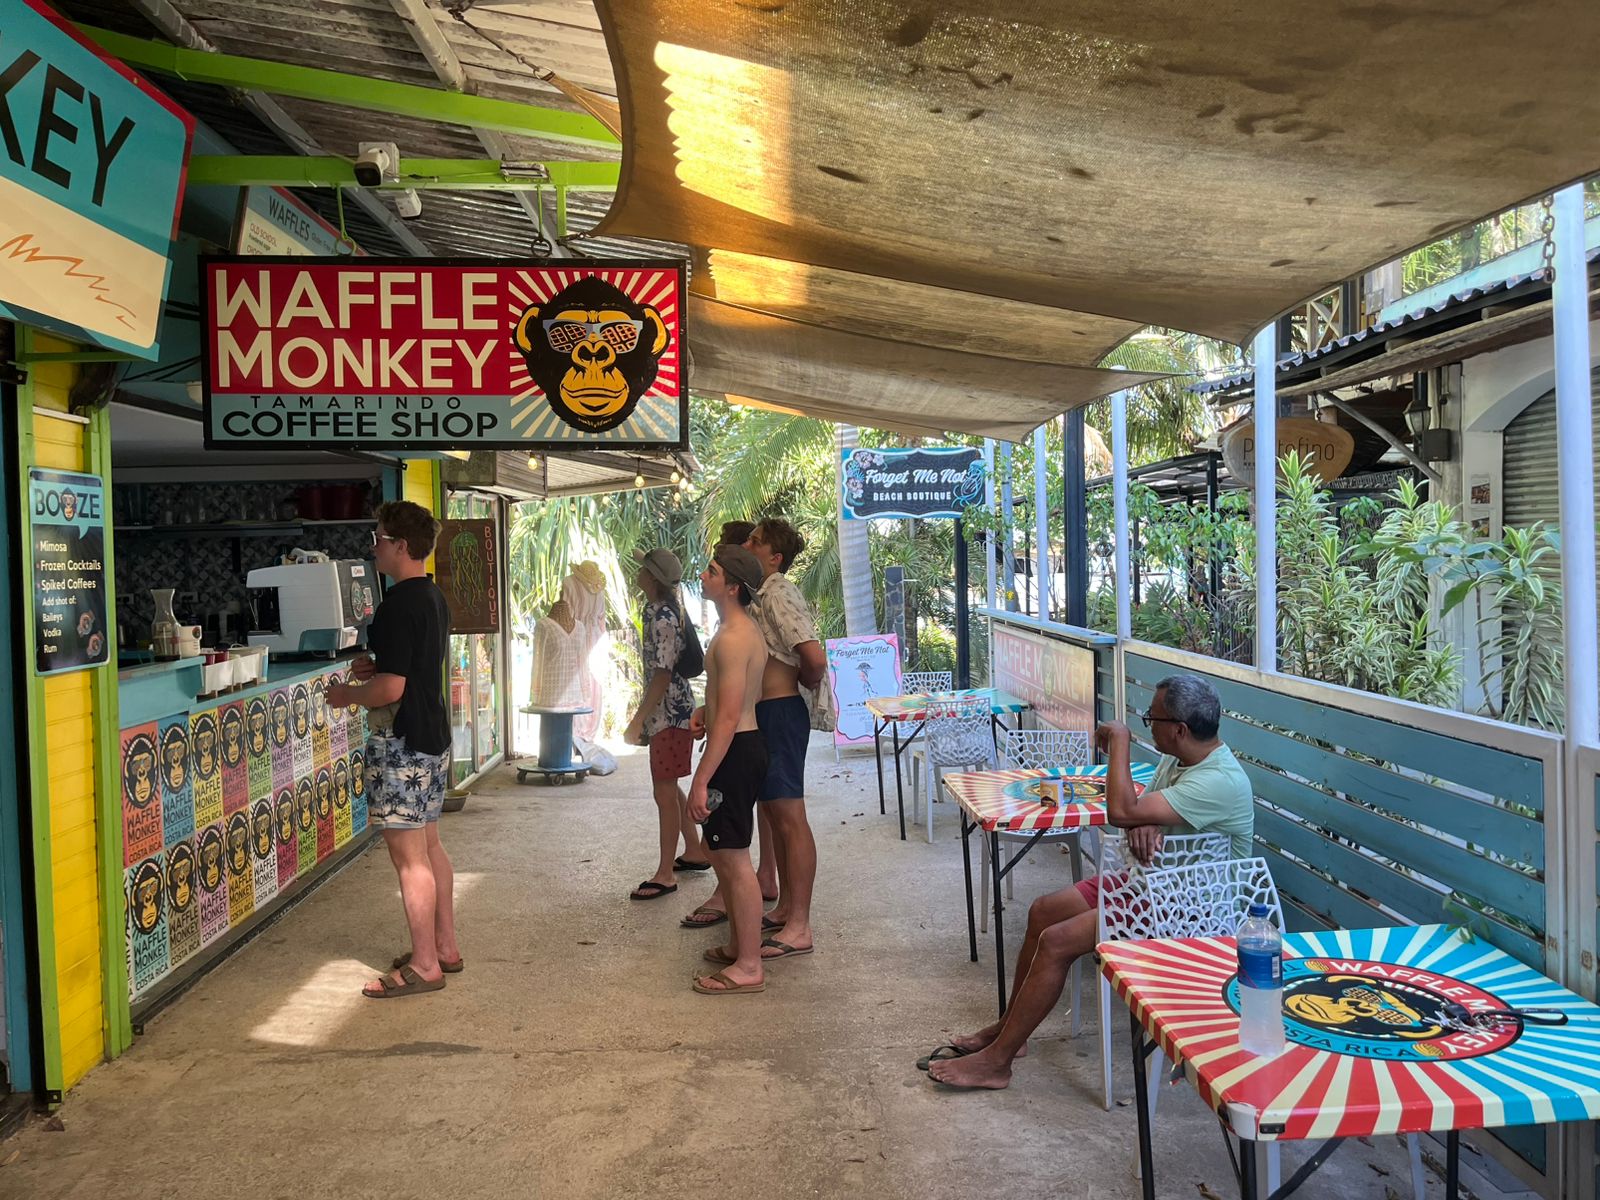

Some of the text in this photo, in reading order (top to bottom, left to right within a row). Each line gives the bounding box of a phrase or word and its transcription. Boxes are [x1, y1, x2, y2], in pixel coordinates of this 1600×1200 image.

[269, 195, 311, 241] WAFFLES
[215, 269, 498, 330] WAFFLE
[218, 330, 499, 388] MONKEY
[250, 395, 462, 409] TAMARINDO
[222, 411, 499, 438] COFFEE SHOP
[1243, 436, 1335, 461] Ptofino
[865, 468, 968, 488] Forget Me Not
[873, 491, 951, 501] BEACH BOUTIQUE
[40, 541, 67, 552] Mimosa
[40, 560, 101, 571] Frozen Cocktails
[484, 526, 497, 624] BOUTIQUE
[41, 578, 97, 592] Spiked Coffees
[42, 597, 54, 606] Add
[55, 597, 68, 606] shot
[42, 612, 63, 623] Baileys
[43, 629, 62, 638] Vodka
[44, 645, 58, 654] Rum
[836, 648, 861, 659] Forget
[861, 647, 874, 655] Me
[875, 646, 890, 654] Not
[994, 633, 1031, 678] WAFFLE
[273, 746, 293, 763] WAFFLE
[294, 737, 311, 754] WAFFLE
[249, 755, 271, 773] WAFFLE
[195, 777, 221, 796] WAFFLE
[249, 767, 271, 785] MONKEY
[163, 789, 193, 812] WAFFLE
[195, 791, 221, 809] MONKEY
[128, 804, 161, 831] WAFFLE
[164, 804, 193, 827] MONKEY
[196, 816, 211, 829] COSTA
[212, 810, 223, 820] RICA
[128, 820, 161, 844] MONKEY
[129, 848, 148, 863] COSTA
[149, 841, 162, 853] RICA
[255, 854, 276, 877] WAFFLE
[229, 870, 253, 896] WAFFLE
[255, 867, 276, 889] MONKEY
[201, 886, 227, 914] WAFFLE
[230, 884, 253, 907] MONKEY
[169, 906, 198, 935] WAFFLE
[201, 901, 227, 926] MONKEY
[231, 909, 244, 922] COSTA
[134, 927, 167, 957] WAFFLE
[170, 921, 198, 947] MONKEY
[202, 928, 218, 943] COSTA
[218, 919, 229, 931] RICA
[135, 942, 167, 972] MONKEY
[171, 949, 188, 966] COSTA
[189, 940, 200, 953] RICA
[136, 972, 155, 991] COSTA
[155, 962, 169, 977] RICA
[1330, 961, 1473, 997] WAFFLE
[1282, 1025, 1414, 1058] STA RICA
